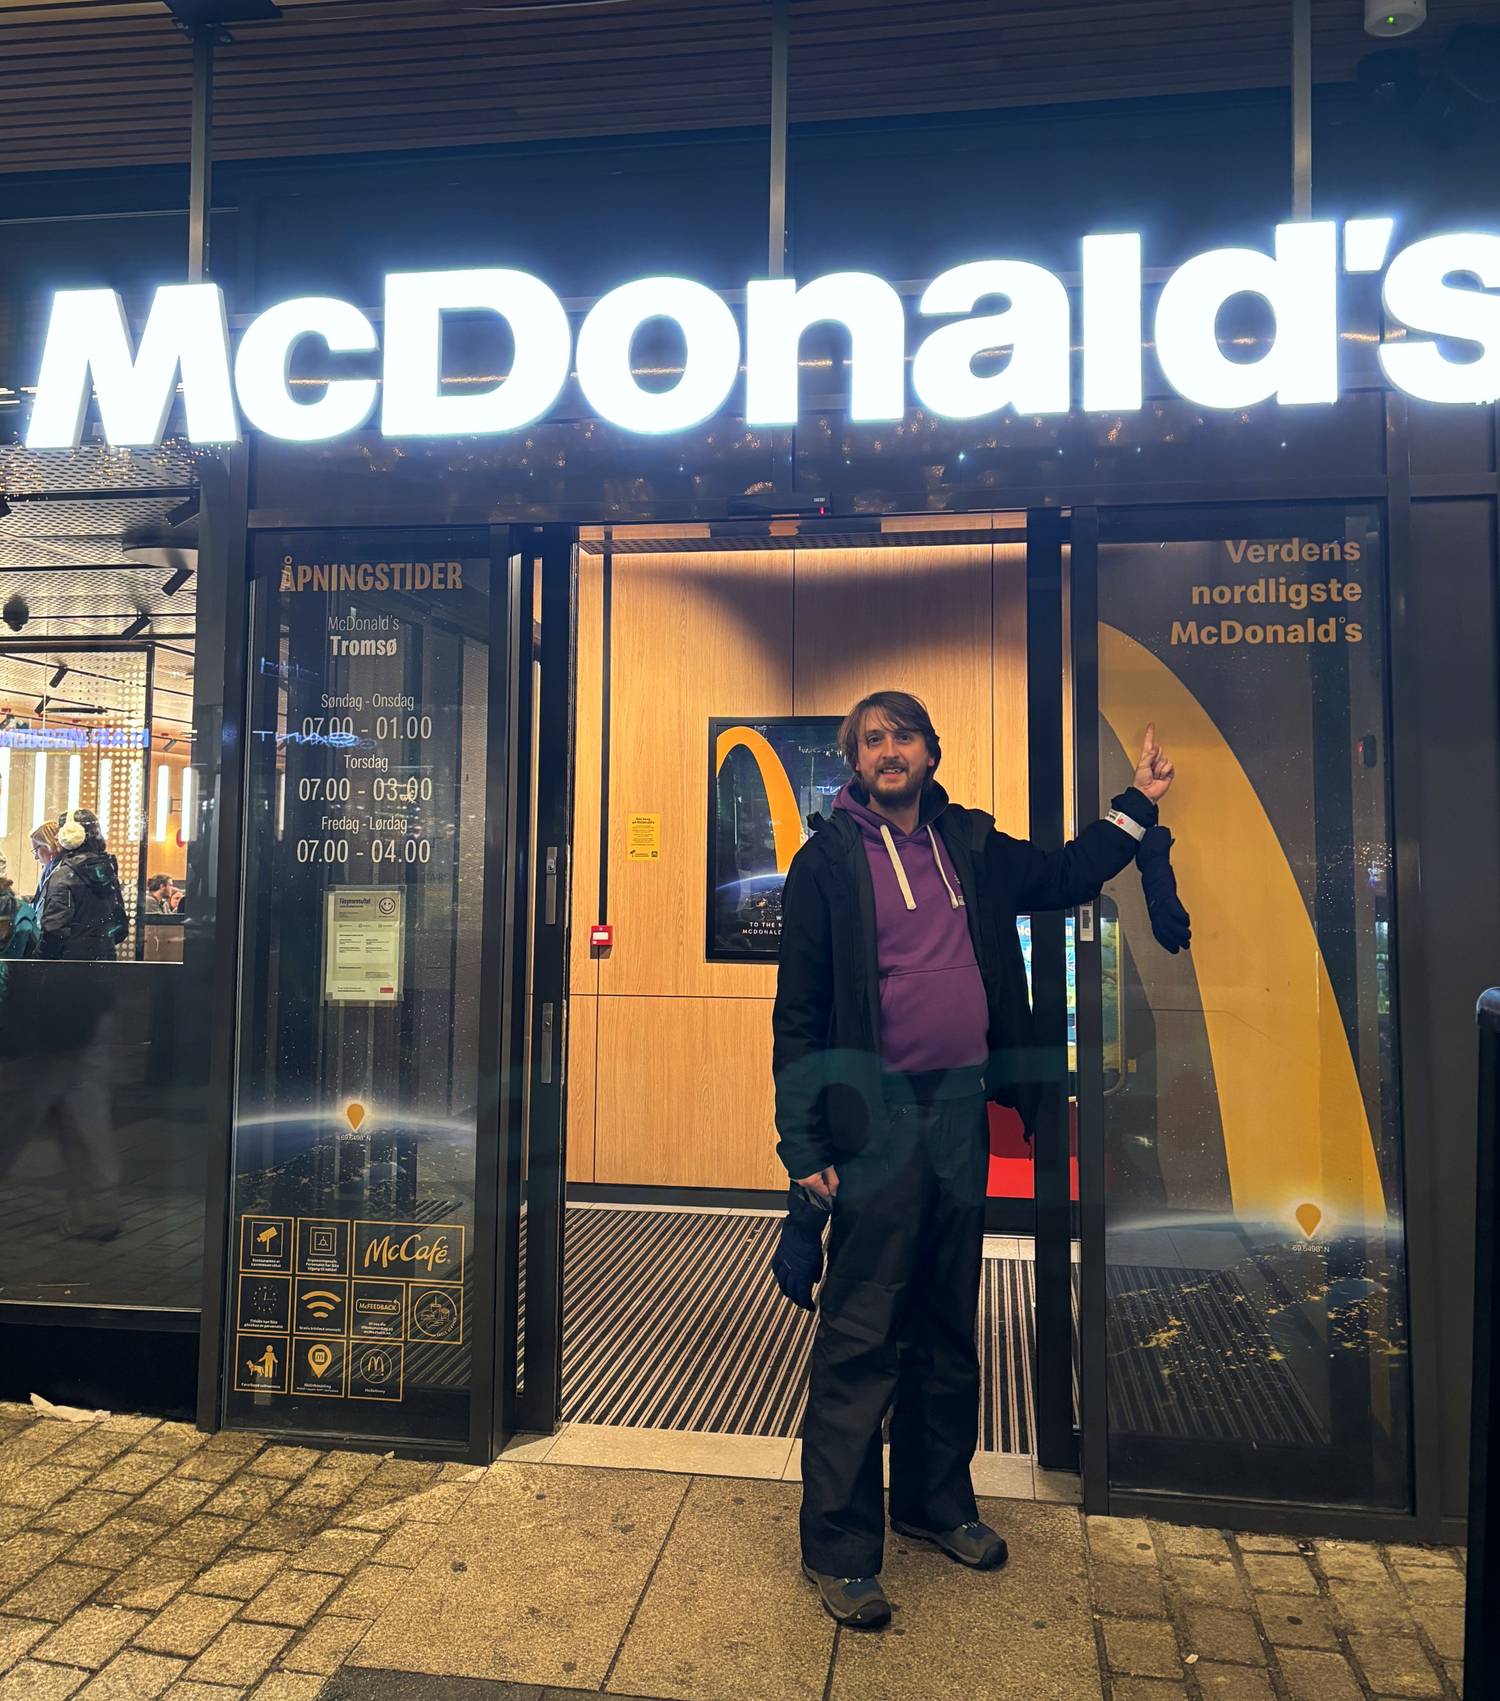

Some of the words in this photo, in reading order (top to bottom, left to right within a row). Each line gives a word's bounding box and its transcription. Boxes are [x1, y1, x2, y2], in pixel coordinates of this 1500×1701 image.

[25, 218, 1500, 447] McDonald's
[1224, 538, 1361, 564] Verdens
[279, 555, 463, 592] ÅPNINGSTIDER
[1191, 577, 1362, 610] nordligste
[328, 615, 399, 631] McDonald's
[330, 635, 397, 657] Tromsø
[321, 693, 362, 711] Søndag
[372, 693, 414, 711] Onsdag
[376, 716, 432, 740] 01.00
[344, 754, 389, 772] Torsdag
[299, 777, 350, 801] 07.00
[321, 816, 360, 834] Fredag
[369, 816, 408, 834] Lørdag
[297, 839, 349, 863] 07.00
[371, 839, 431, 863] 04.00
[364, 1234, 449, 1272] McCafé
[359, 1303, 397, 1311] McFEEDBACK
